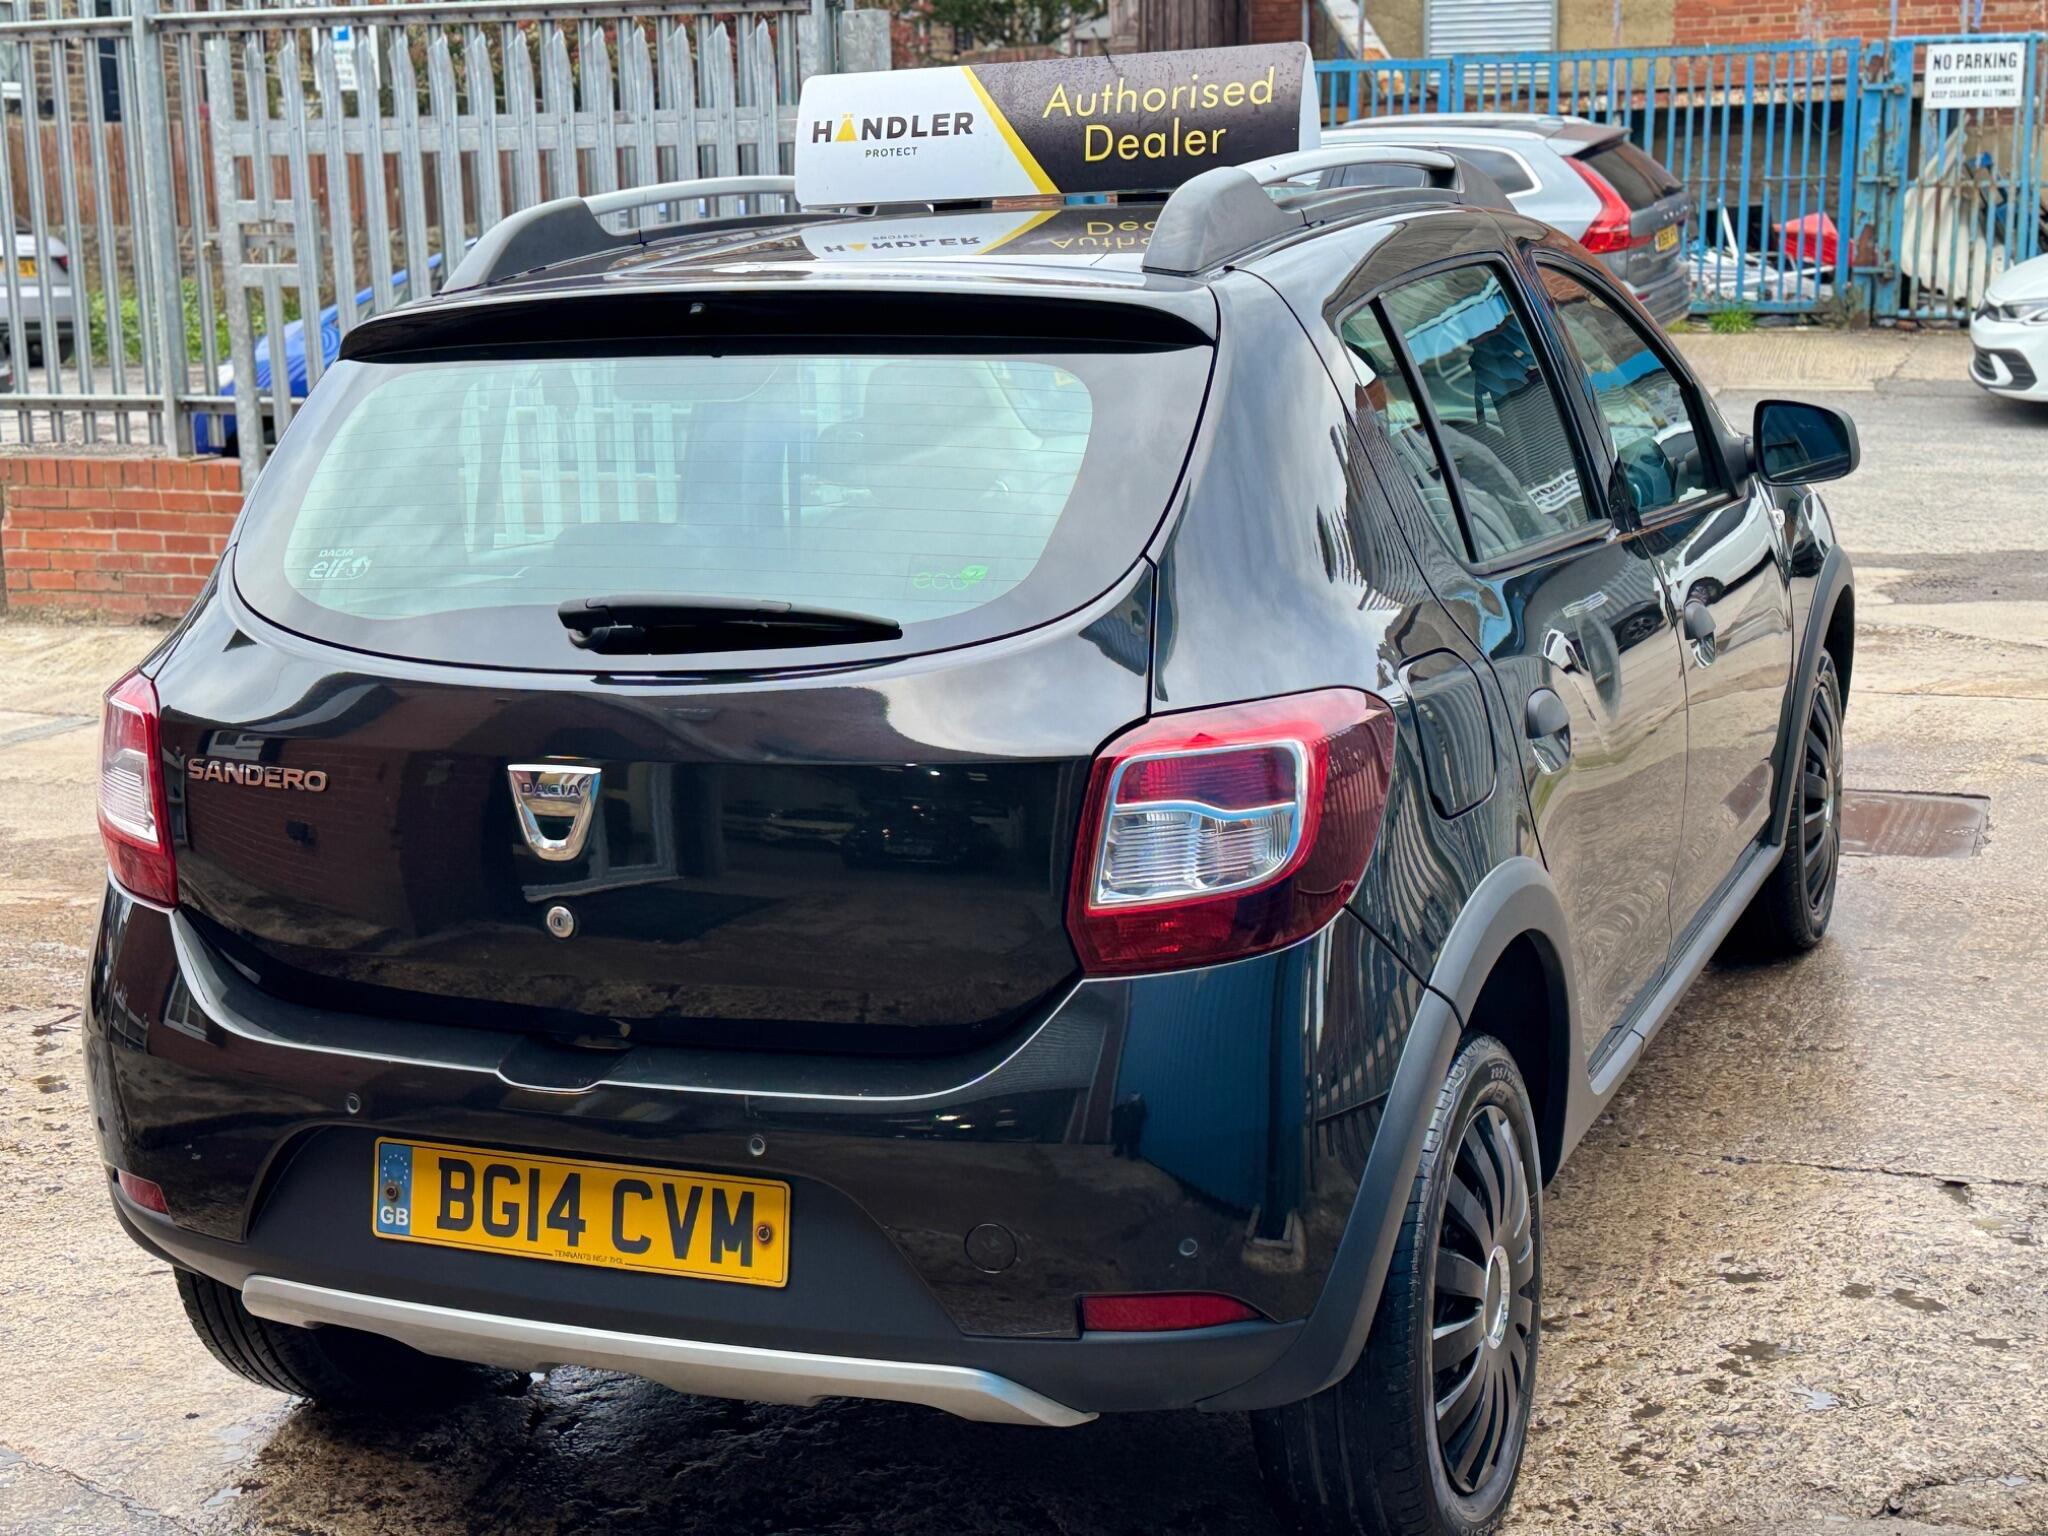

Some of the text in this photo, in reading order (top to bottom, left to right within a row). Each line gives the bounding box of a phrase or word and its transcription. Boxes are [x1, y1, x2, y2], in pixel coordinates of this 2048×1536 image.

[1933, 52, 2018, 70] NO PARKING
[1042, 65, 1276, 119] Authorised
[1972, 88, 1980, 97] AT
[1982, 88, 1993, 97] ALL
[1085, 117, 1227, 162] Dealer
[865, 146, 918, 158] PROTECT
[318, 548, 354, 558] DACIA
[911, 571, 969, 591] eco
[187, 757, 329, 793] SANDERO
[521, 783, 581, 797] DACIA
[380, 1205, 409, 1226] GB
[436, 1156, 755, 1268] BG14 CVM
